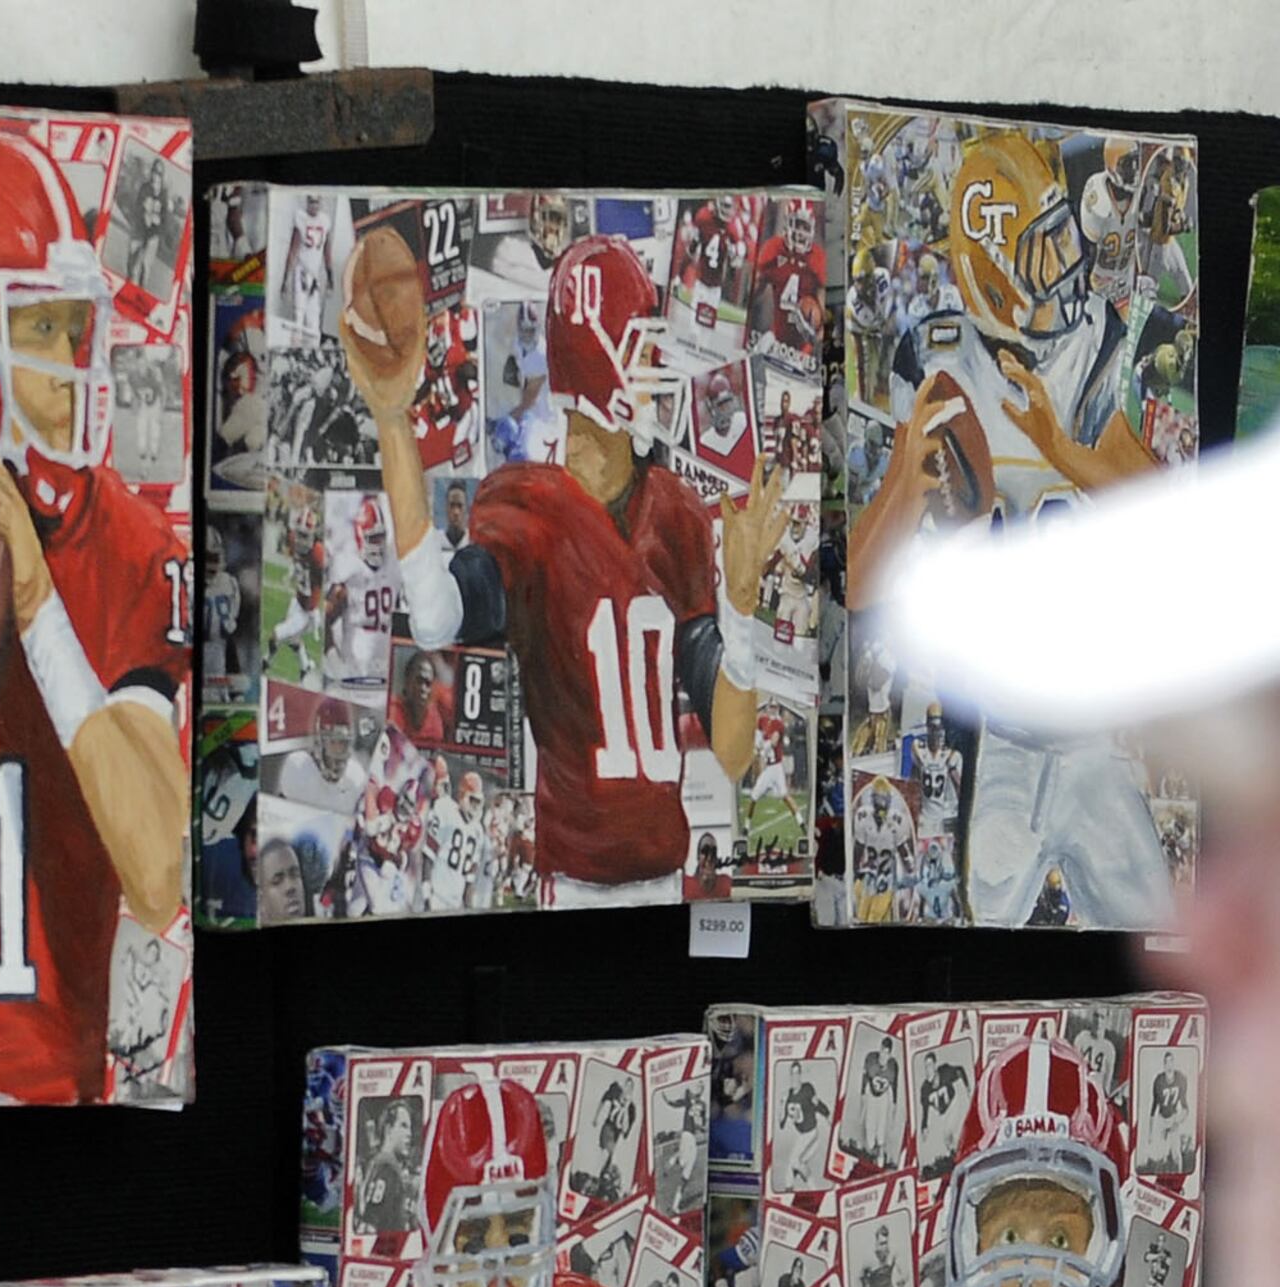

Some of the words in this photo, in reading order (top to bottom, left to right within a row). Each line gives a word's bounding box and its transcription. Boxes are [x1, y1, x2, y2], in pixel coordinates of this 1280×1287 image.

[424, 202, 460, 266] 22
[571, 265, 602, 326] 10
[463, 663, 482, 720] 8
[586, 595, 682, 783] 10
[698, 918, 745, 933] $299.00
[1015, 1117, 1057, 1138] BAMA
